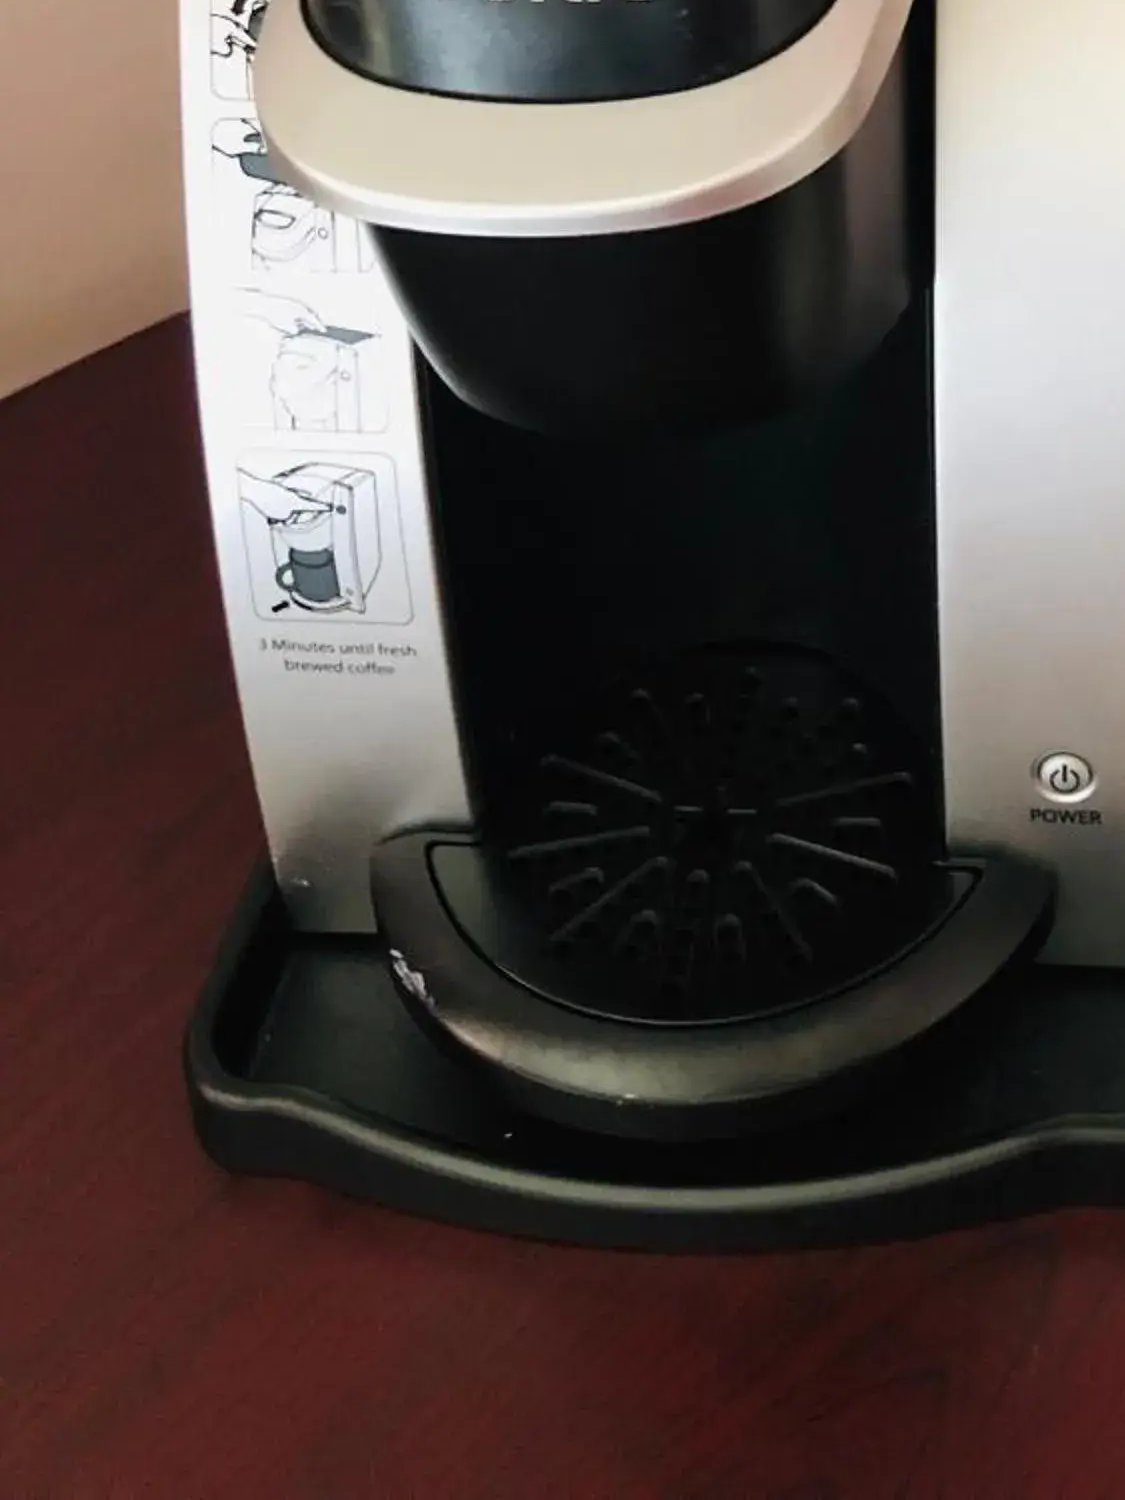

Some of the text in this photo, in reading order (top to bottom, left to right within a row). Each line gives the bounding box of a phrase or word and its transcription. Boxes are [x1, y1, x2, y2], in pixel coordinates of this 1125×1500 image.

[272, 639, 335, 654] Minutes
[340, 643, 374, 656] until
[378, 643, 417, 657] fresh
[284, 659, 396, 675] brewed coffee
[1030, 808, 1102, 825] POWER
